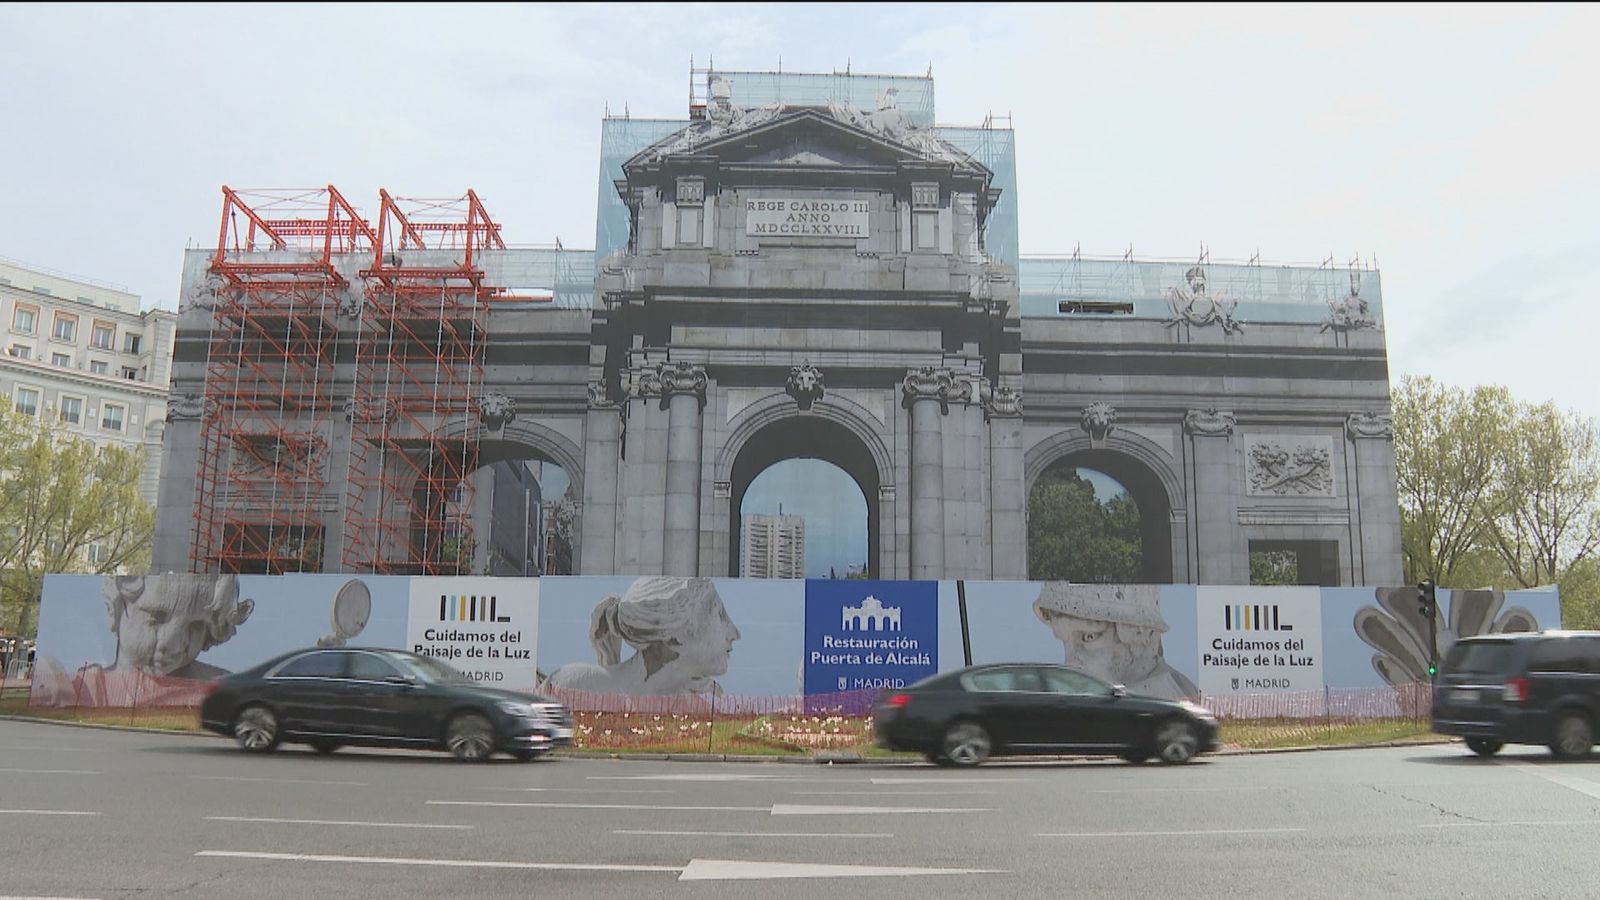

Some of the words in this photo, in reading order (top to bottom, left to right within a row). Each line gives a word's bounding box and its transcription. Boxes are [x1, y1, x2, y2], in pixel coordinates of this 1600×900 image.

[747, 201, 785, 211] REGE
[790, 202, 849, 212] CAROLO
[853, 203, 869, 213] III
[786, 213, 831, 222] ANNO
[755, 223, 861, 234] MDCCLXXVIII
[424, 629, 495, 642] Cuidamos
[499, 630, 521, 643] del
[823, 635, 919, 649] Restauración
[1212, 638, 1280, 651] Cuidamos
[1284, 638, 1304, 651] del
[414, 645, 462, 660] Paisaje
[466, 646, 484, 658] de
[488, 646, 500, 658] la
[504, 647, 530, 660] Luz
[811, 651, 860, 665] Puerta
[865, 652, 883, 665] de
[886, 652, 931, 665] Alcalá
[1203, 654, 1249, 669] Paisaje
[1253, 654, 1270, 666] de
[1274, 654, 1285, 666] la
[1290, 655, 1314, 667] Luz
[854, 678, 905, 689] MADRID
[1245, 679, 1290, 688] MADRID
